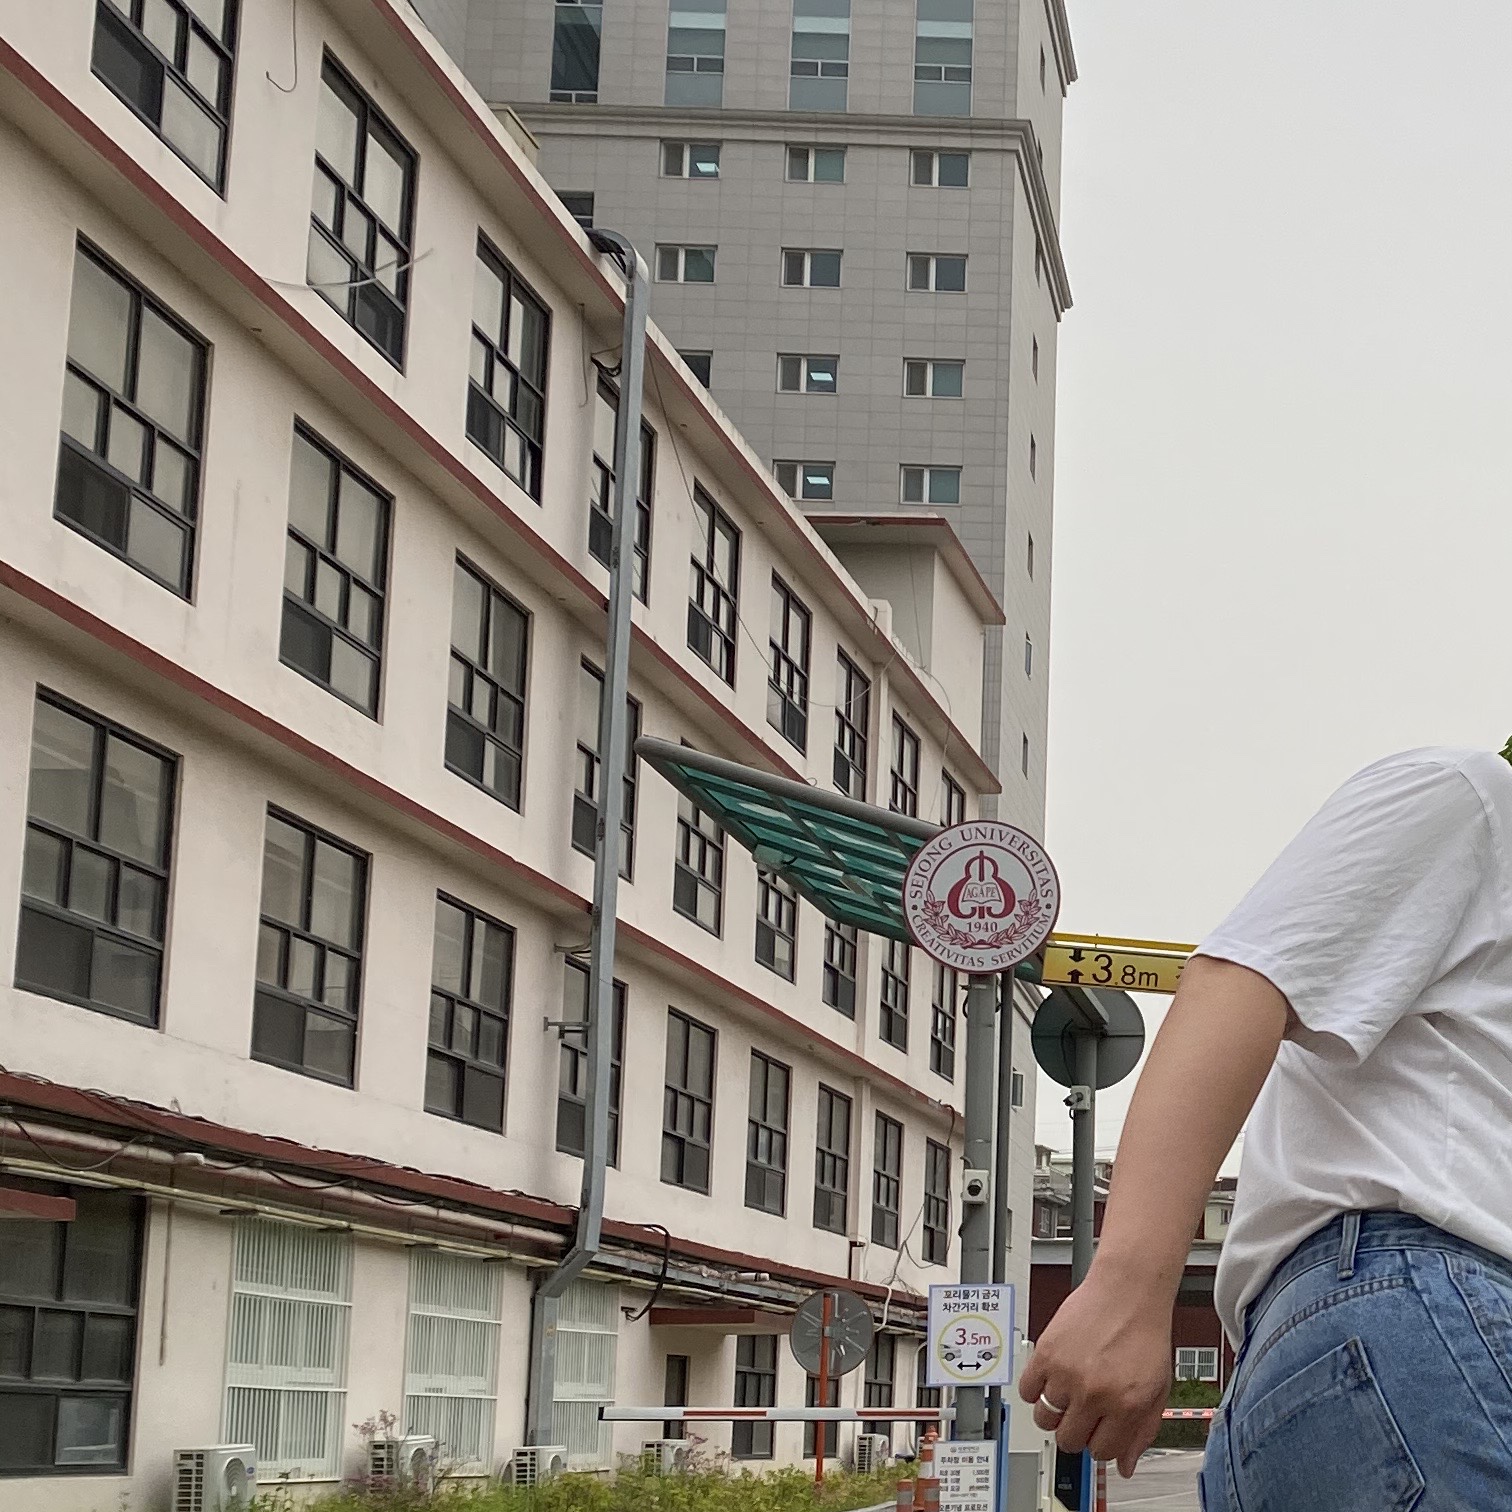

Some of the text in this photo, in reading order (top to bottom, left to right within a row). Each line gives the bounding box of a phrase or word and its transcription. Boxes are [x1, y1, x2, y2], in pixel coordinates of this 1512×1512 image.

[910, 826, 1054, 899] SEJONG UNIVERSITAS
[965, 886, 996, 898] AGAPE
[966, 921, 998, 933] 1940
[912, 913, 1051, 968] CREATIVITAS SERVITIUM
[1092, 953, 1159, 987] 3.8m
[943, 1289, 1000, 1300] 꼬리물기 금지
[942, 1302, 1000, 1313] 차간거리 확보
[955, 1328, 991, 1345] 3.5m
